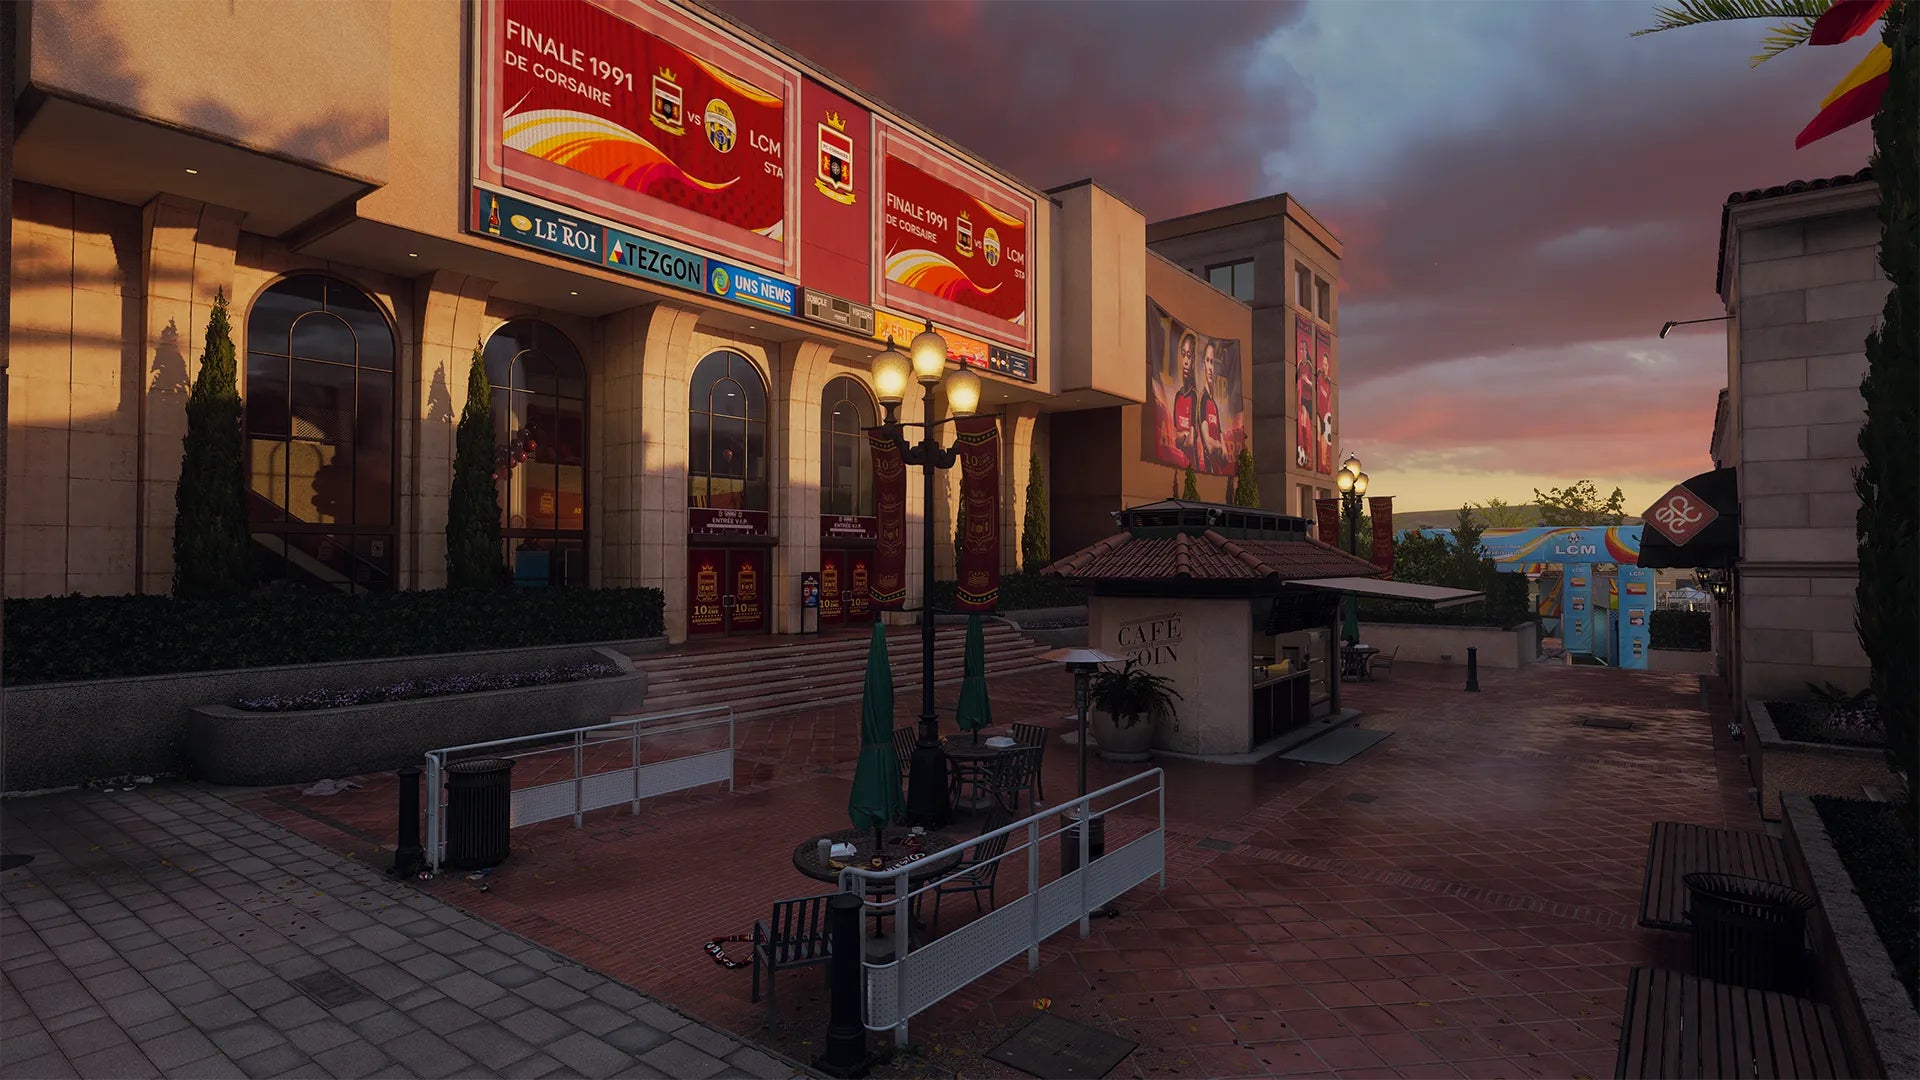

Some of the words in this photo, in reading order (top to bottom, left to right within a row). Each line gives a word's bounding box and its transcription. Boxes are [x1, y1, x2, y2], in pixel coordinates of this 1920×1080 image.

[506, 19, 584, 71] FINALE
[589, 56, 633, 92] 1991
[504, 50, 528, 72] DE
[532, 63, 612, 108] CORSAIRE
[749, 129, 781, 158] LCM
[764, 161, 784, 179] STA
[887, 192, 924, 220] FINALE
[925, 209, 948, 231] 1991
[534, 217, 557, 243] LE
[563, 225, 597, 254] ROI
[886, 214, 897, 227] DE
[899, 219, 938, 244] CORSAIRE
[625, 242, 701, 284] TEZGON
[1006, 247, 1025, 266] LCM
[735, 274, 759, 293] UNS
[761, 281, 791, 304] NEWS
[1555, 545, 1596, 555] LCM
[694, 605, 708, 615] 10
[735, 603, 747, 613] 10
[1118, 613, 1181, 646] CAFÉ
